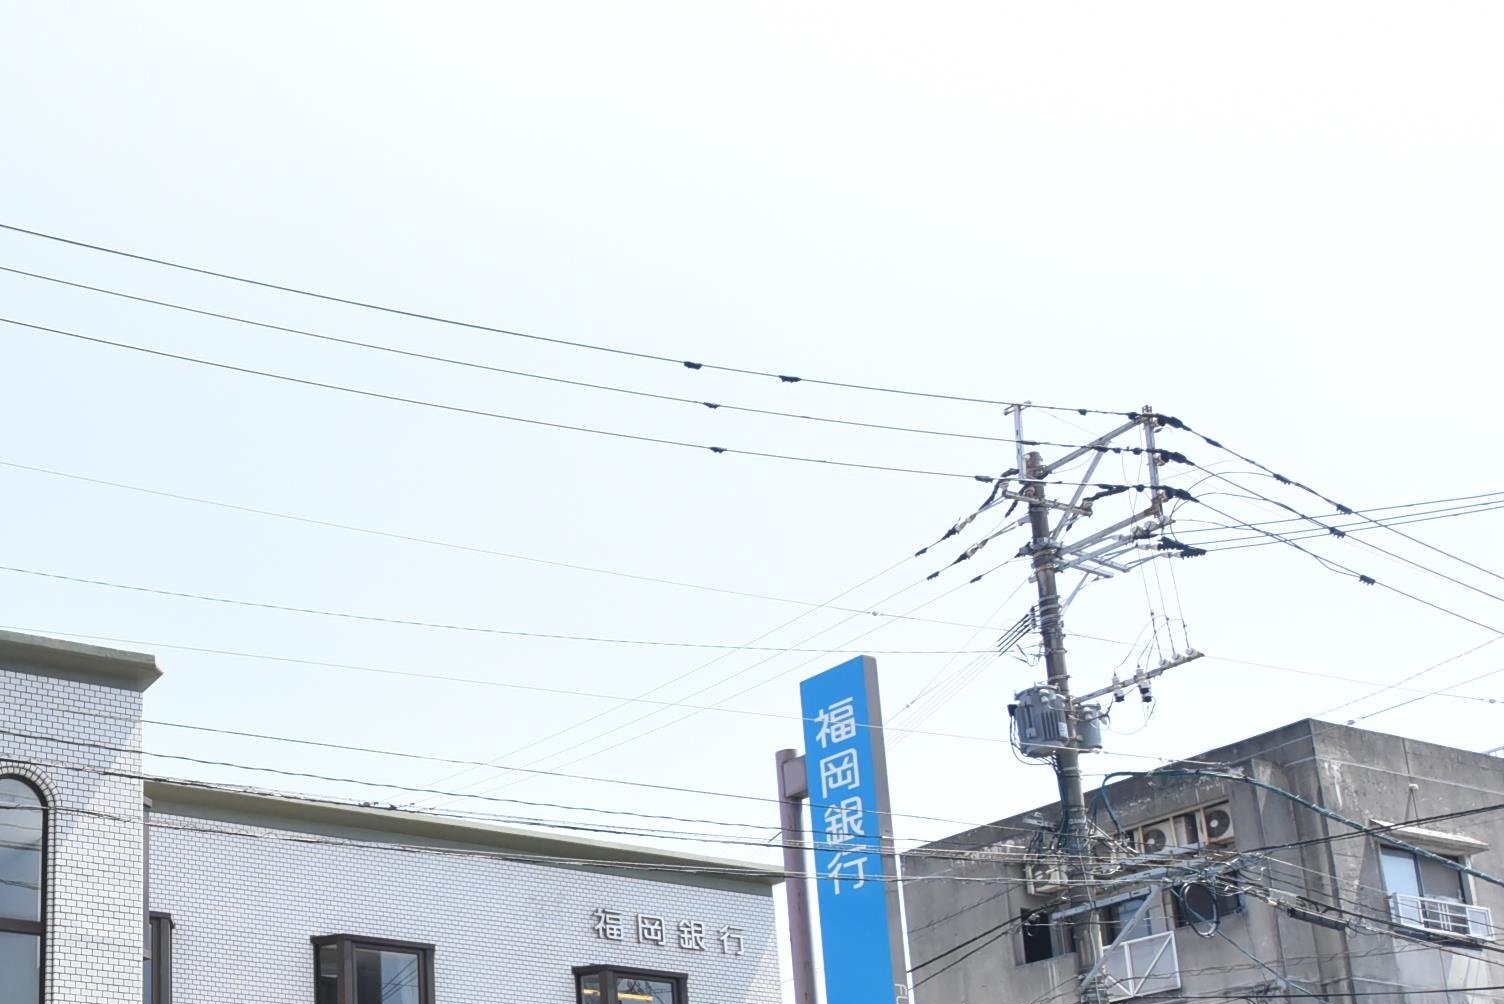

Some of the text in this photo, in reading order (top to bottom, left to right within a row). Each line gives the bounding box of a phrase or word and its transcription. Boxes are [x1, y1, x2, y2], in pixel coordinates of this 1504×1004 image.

[814, 696, 868, 895] 福岡銀行
[592, 908, 745, 956] 福岡銀行
